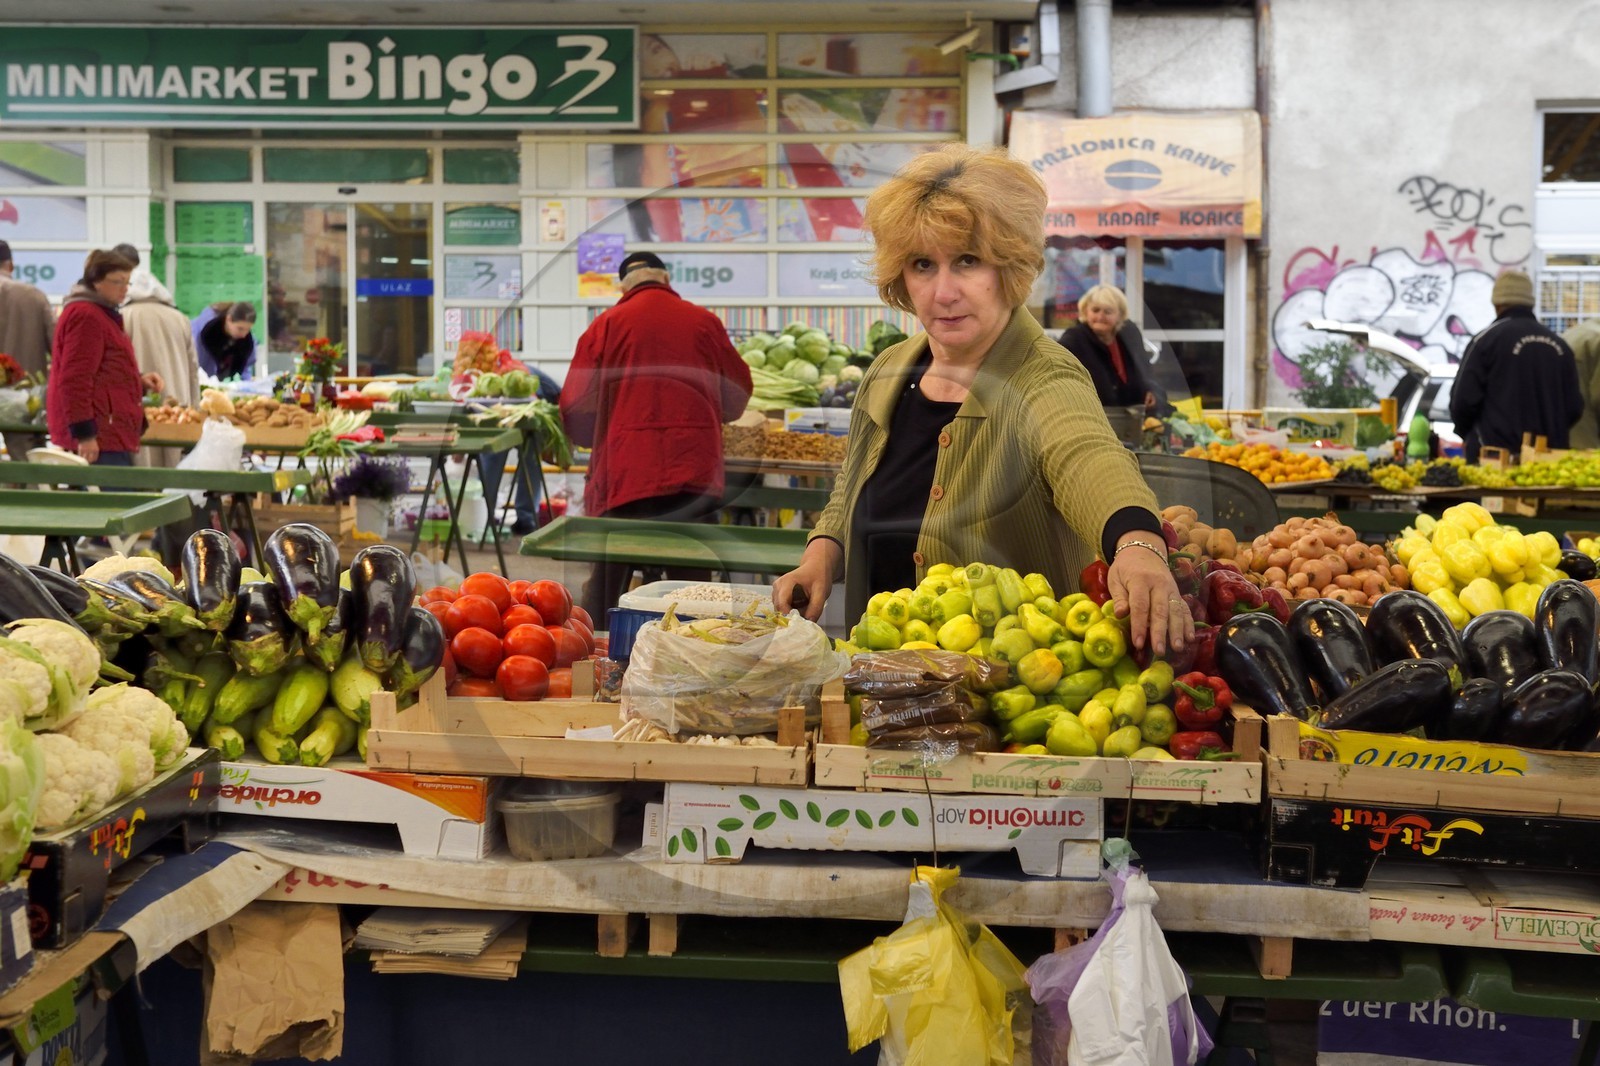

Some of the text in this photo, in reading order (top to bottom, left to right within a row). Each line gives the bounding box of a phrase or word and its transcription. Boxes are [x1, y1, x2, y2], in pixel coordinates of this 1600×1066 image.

[7, 37, 537, 116] MINIMARKET Bingo
[449, 218, 517, 229] MINIMARKET
[380, 283, 412, 292] ULAZ
[217, 784, 322, 808] orchide
[936, 808, 966, 824] AOP
[969, 806, 1085, 830] armonia
[1411, 912, 1456, 930] buona
